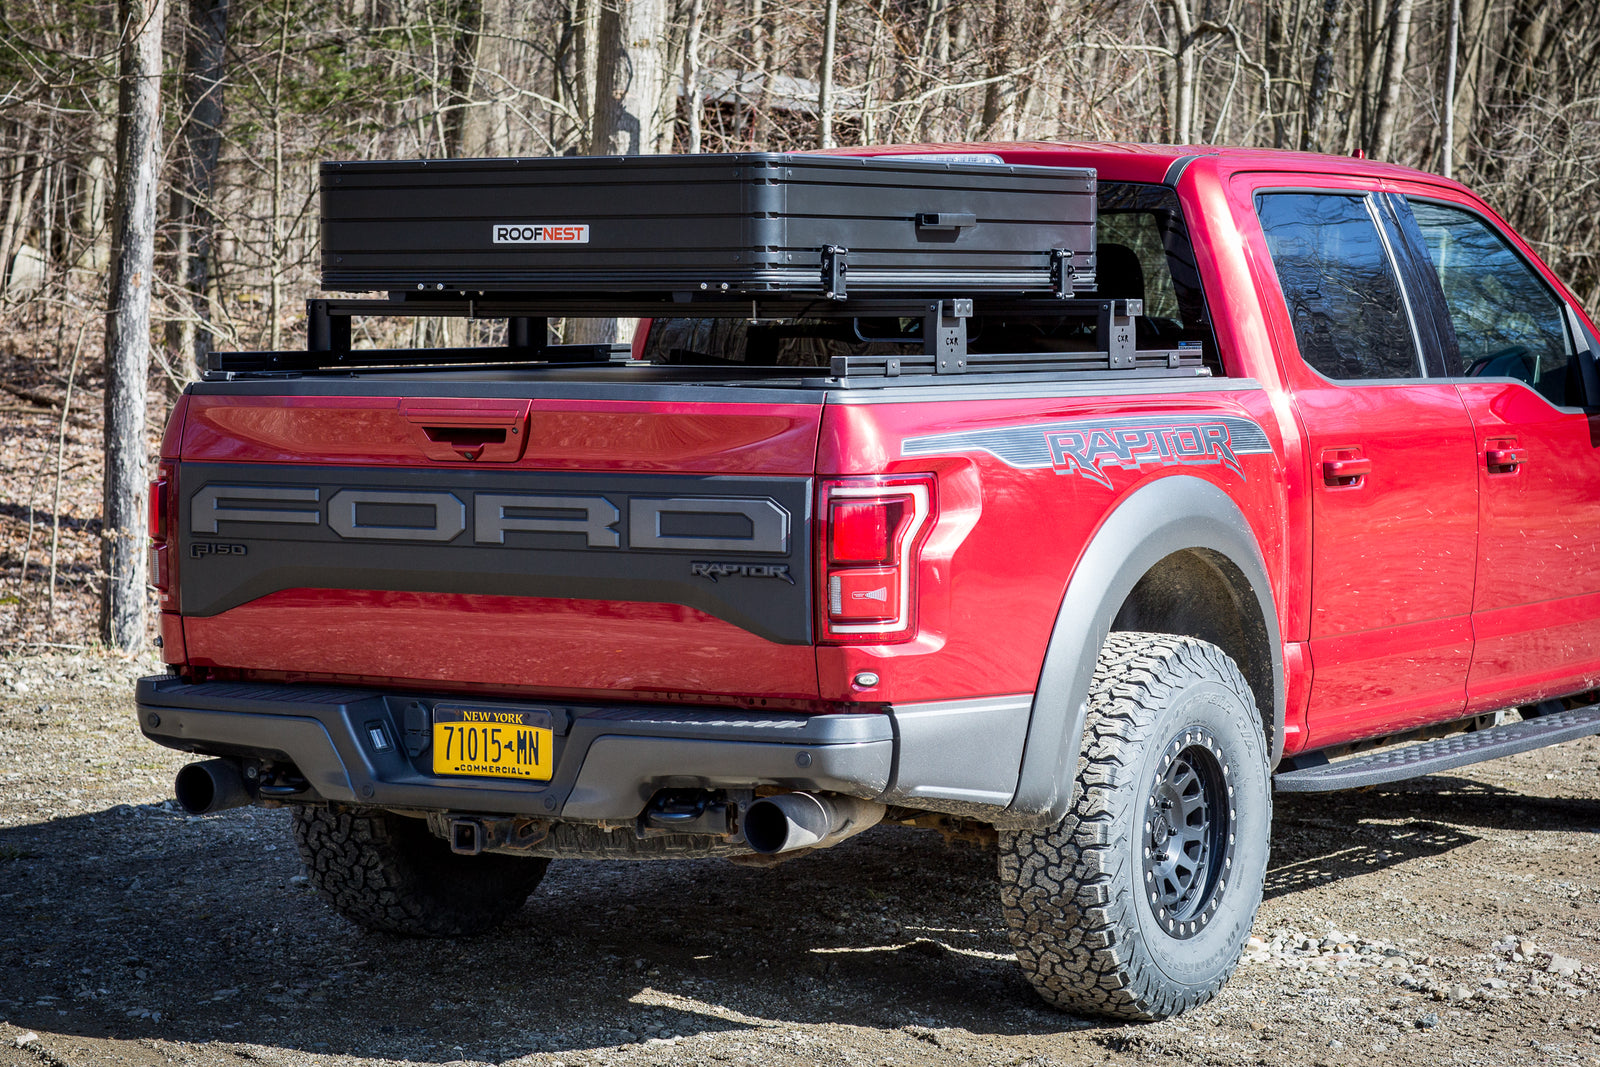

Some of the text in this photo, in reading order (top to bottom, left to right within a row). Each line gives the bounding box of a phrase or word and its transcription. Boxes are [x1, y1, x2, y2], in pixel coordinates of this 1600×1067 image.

[497, 227, 584, 241] ROOFNEST
[945, 337, 959, 346] CXR
[1117, 334, 1129, 343] CXR
[1044, 422, 1246, 489] RAPTOR
[191, 484, 791, 552] FORD
[690, 561, 795, 585] RAPTOR
[463, 711, 523, 724] NEW YORK
[444, 726, 539, 766] 71015 MN
[460, 764, 523, 775] COMMERCIAL
